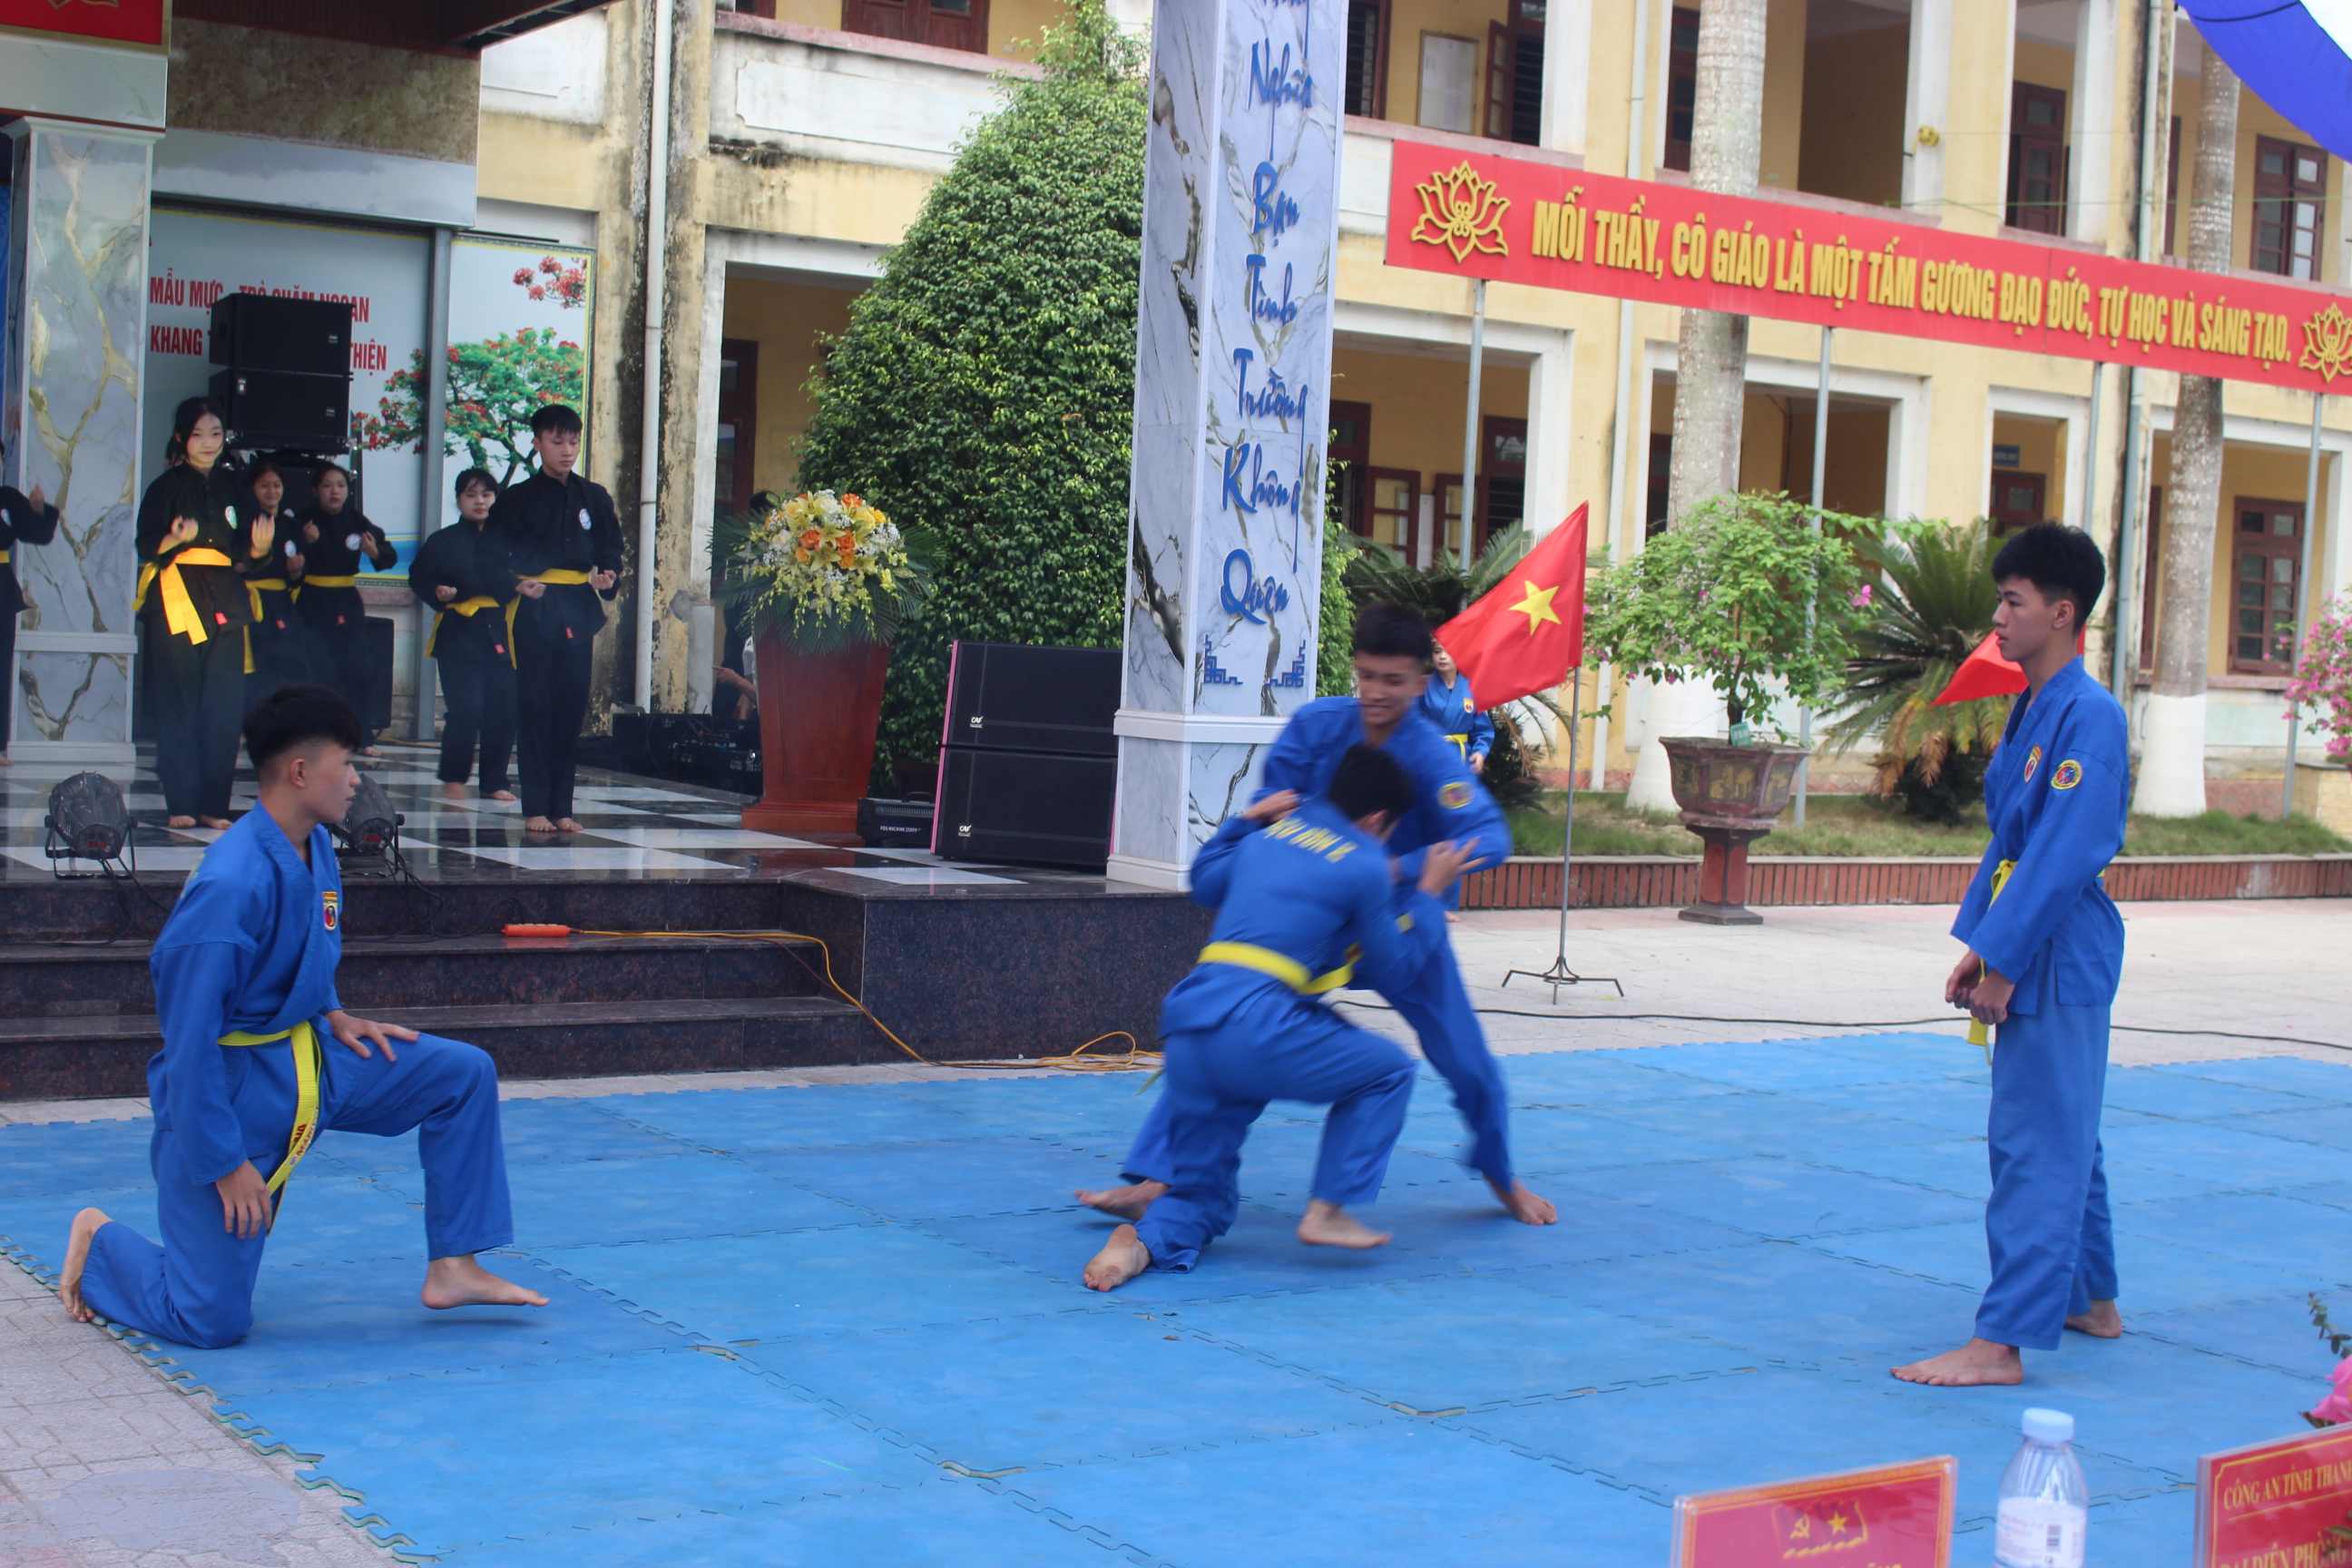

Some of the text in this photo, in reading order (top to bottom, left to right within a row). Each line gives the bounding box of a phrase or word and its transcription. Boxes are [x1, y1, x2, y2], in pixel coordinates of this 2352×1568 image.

[1247, 36, 1313, 162] Nghĩa
[1250, 161, 1301, 248] Bạn
[150, 267, 184, 307] MẪU
[1246, 253, 1298, 326] Tình
[1531, 186, 2291, 370] MỖI THẦY, CÔ GIÁO LÀ MỘT TẤM GƯƠNG ĐẠO ĐỨC, TỰ HỌC VÀ SÁNG TẠO.
[150, 324, 202, 357] KHANG
[1232, 347, 1308, 477] Trường
[1221, 442, 1301, 573] Không
[1219, 548, 1290, 625] Quên
[2224, 1478, 2260, 1510] CÔNG
[2262, 1475, 2281, 1501] AN
[2282, 1464, 2314, 1496] TỈNH
